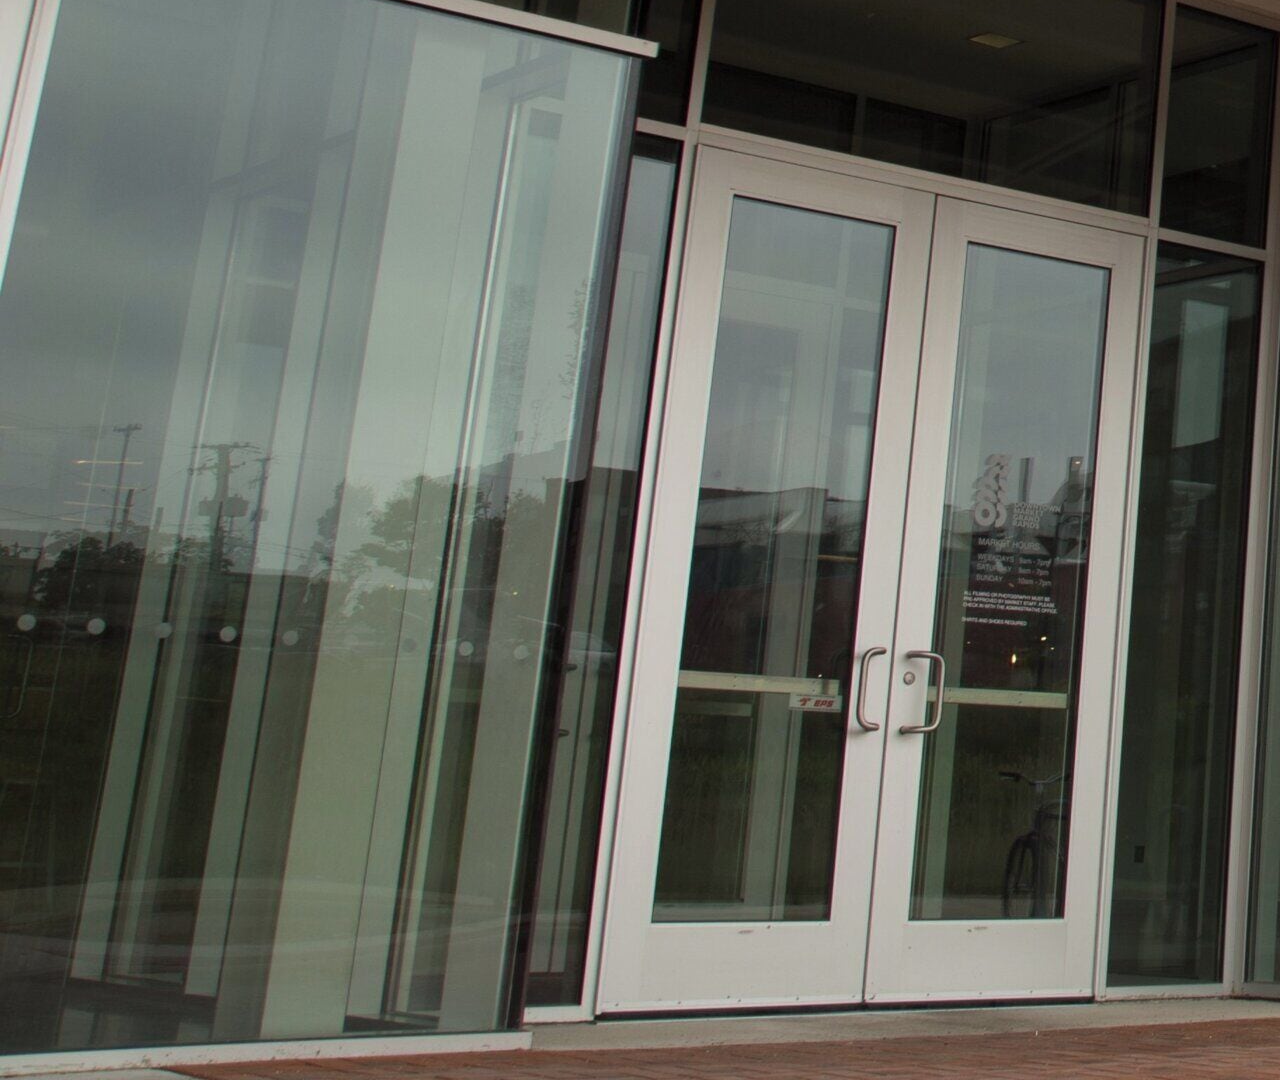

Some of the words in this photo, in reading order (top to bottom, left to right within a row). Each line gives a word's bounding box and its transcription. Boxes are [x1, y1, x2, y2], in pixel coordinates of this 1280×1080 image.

[1014, 502, 1061, 513] DOWNTOWN
[978, 537, 1011, 548] MARKET
[1012, 541, 1041, 551] HOURS
[977, 553, 1015, 563] WEEKDAYS
[976, 573, 1003, 582] SUNDAY
